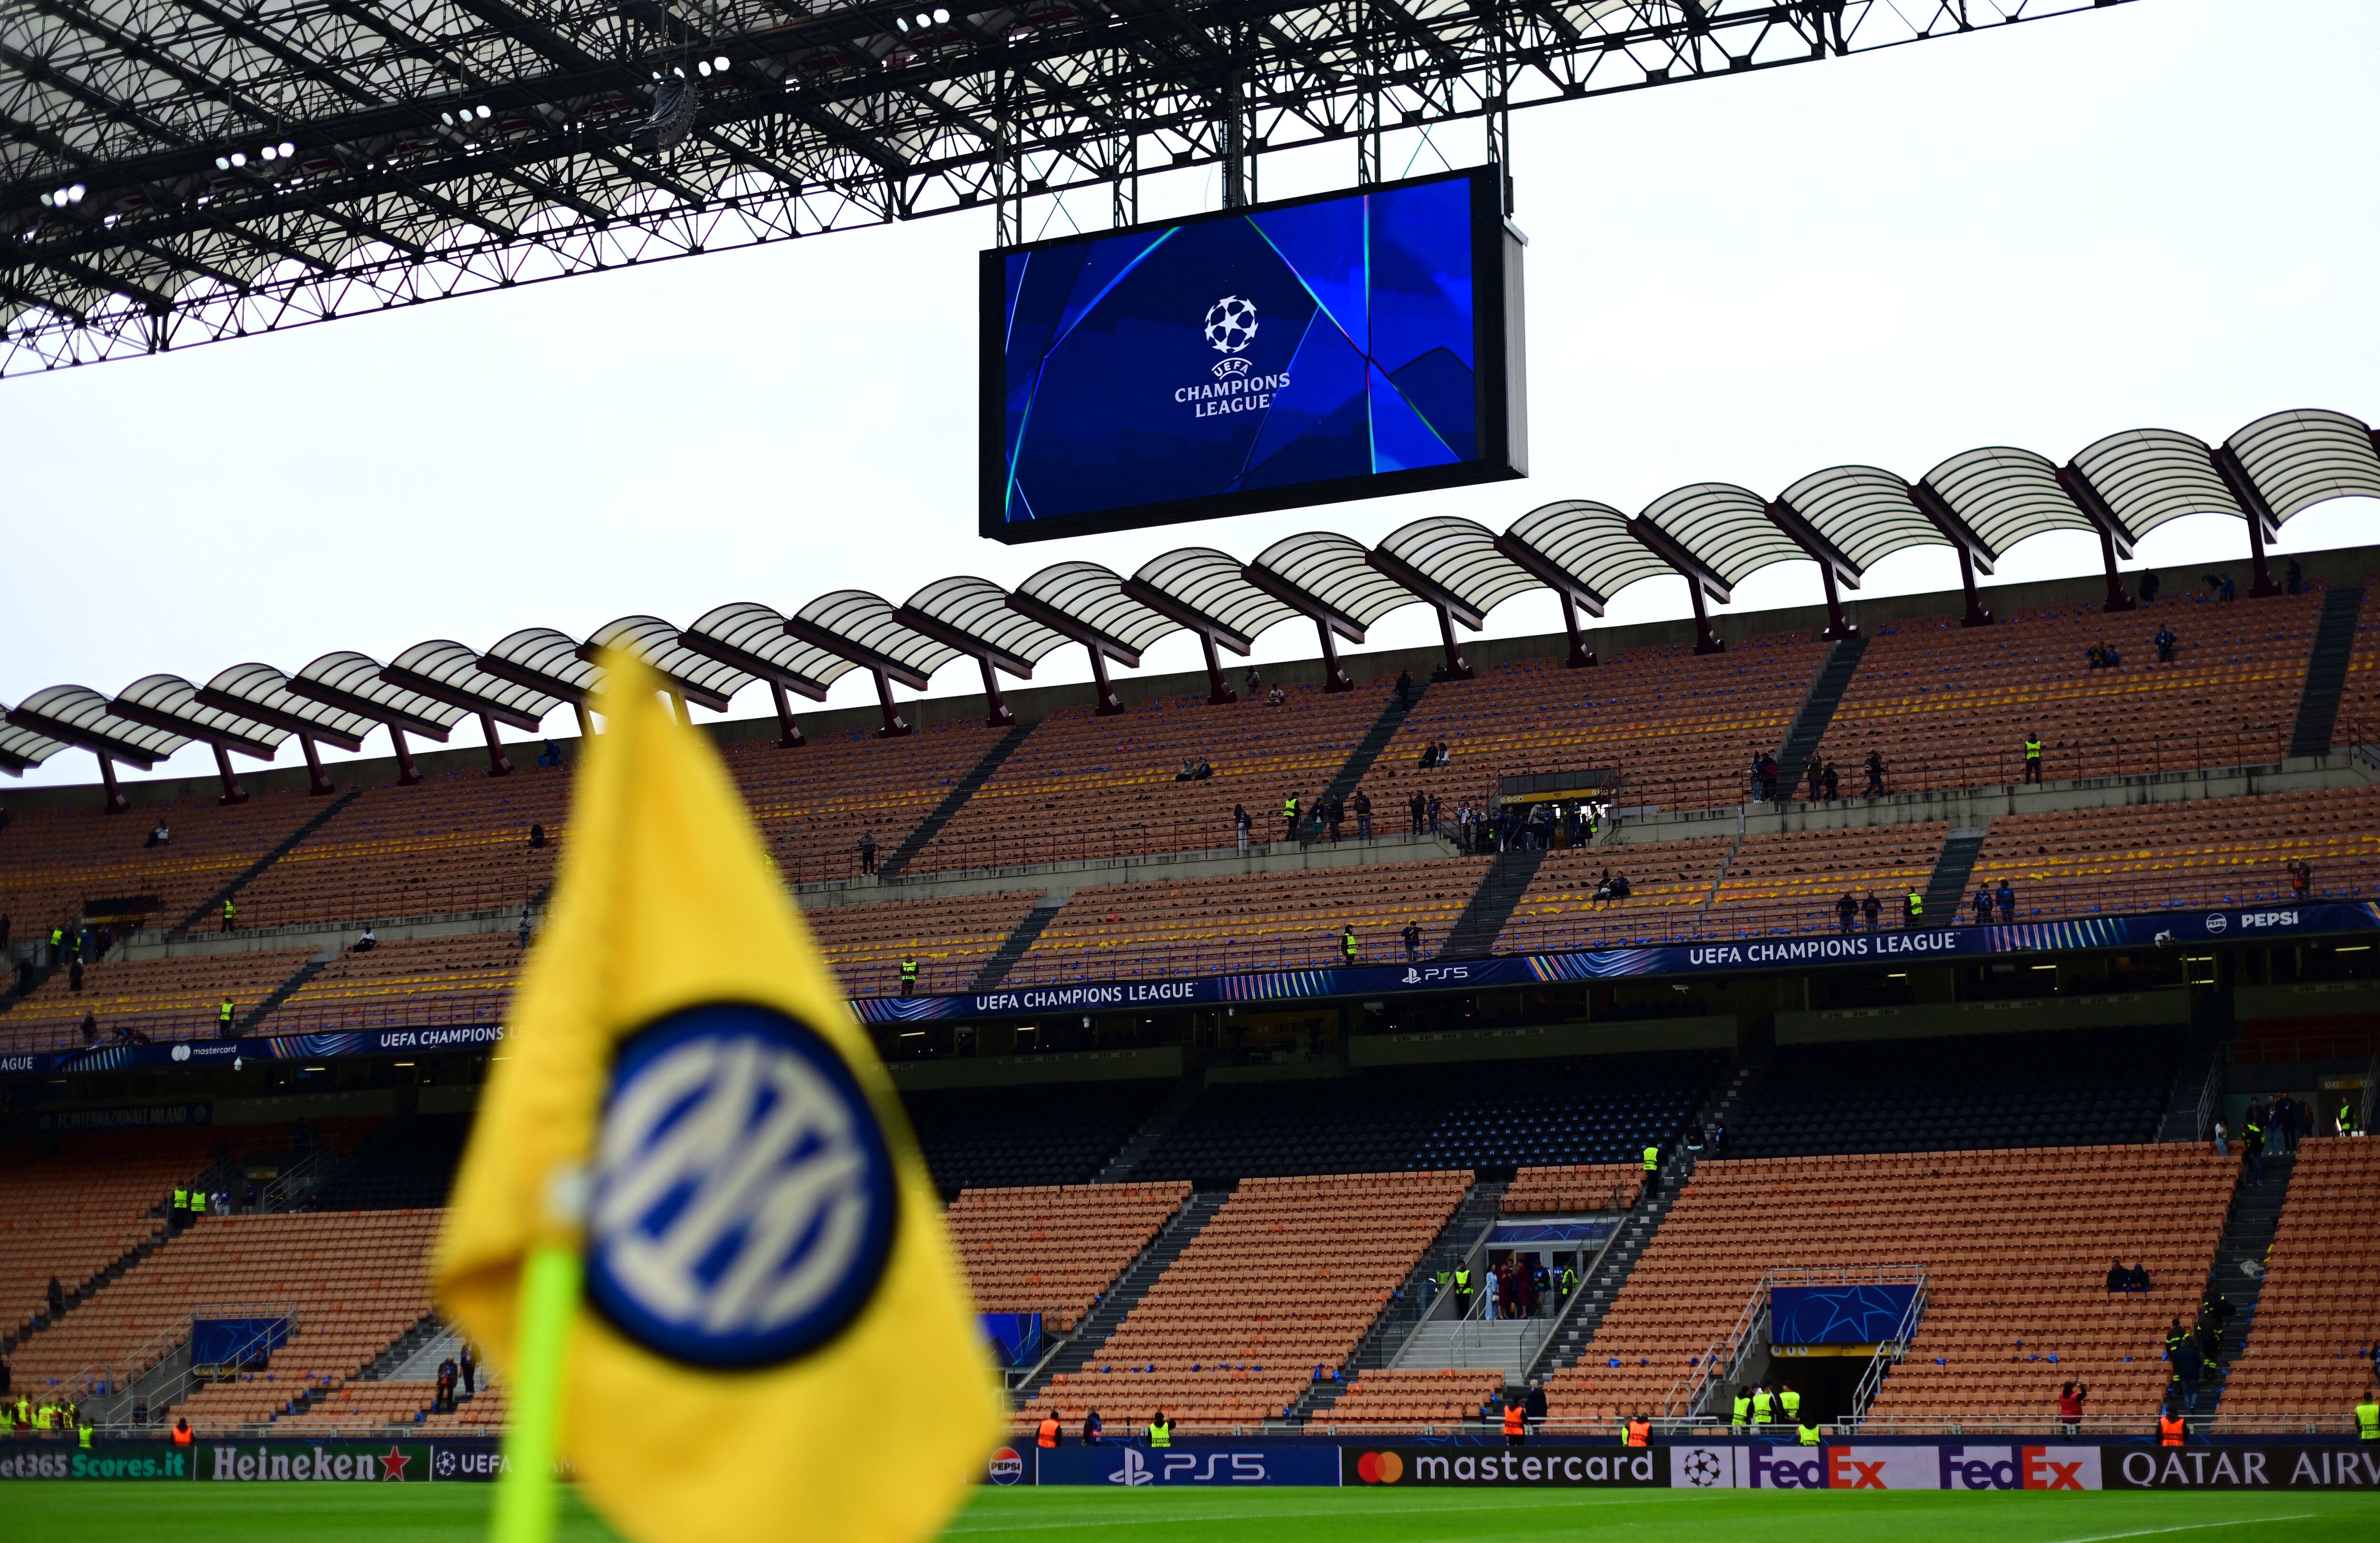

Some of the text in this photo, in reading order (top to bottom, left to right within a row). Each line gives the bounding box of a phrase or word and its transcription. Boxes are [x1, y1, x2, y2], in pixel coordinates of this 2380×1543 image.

[1214, 361, 1249, 377] UEFA
[1175, 372, 1290, 402] CHAMPIONS
[1195, 394, 1270, 418] LEAGUE
[2241, 911, 2298, 927] PEPSI
[1690, 932, 1955, 965] UEFA CHAMPIONS LEAGUE
[1425, 966, 1469, 980] PS5
[976, 983, 1194, 1010] UEFA CHAMPIONS LEAGUE
[380, 1032, 416, 1047] UEFA
[420, 1026, 504, 1045] CHAMPIONS
[193, 1045, 237, 1056] mastercard
[58, 1106, 187, 1129] FC INTERNAZIONALE MILANO
[72, 1452, 185, 1477] Scores.it
[212, 1447, 376, 1481] Heineken
[462, 1454, 514, 1473] UEFA
[991, 1463, 1021, 1471] PEPSI
[1164, 1454, 1265, 1480] PS5
[1417, 1451, 1653, 1480] mastercard
[1749, 1445, 1888, 1489] FedEx
[1938, 1445, 2085, 1490] FedEx
[2122, 1452, 2271, 1487] QATAR
